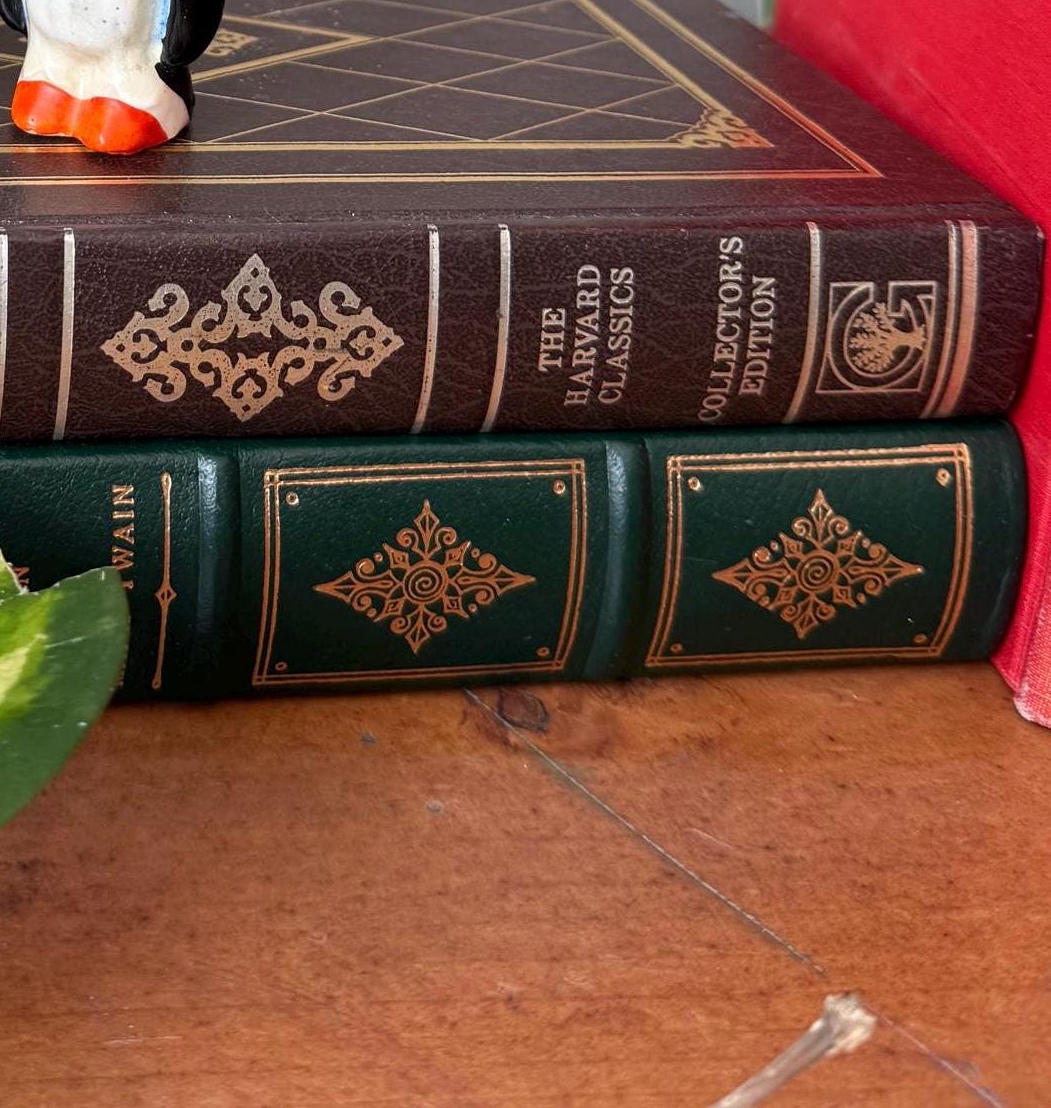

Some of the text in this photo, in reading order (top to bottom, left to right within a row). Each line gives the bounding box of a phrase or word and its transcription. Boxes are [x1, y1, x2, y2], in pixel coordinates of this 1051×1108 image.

[538, 306, 566, 372] THE
[564, 263, 601, 408] HARVARD
[598, 265, 634, 405] CLASSICS
[697, 235, 744, 423] COLLECTOR'S
[739, 274, 777, 397] EDITION
[110, 483, 135, 590] WAIN
